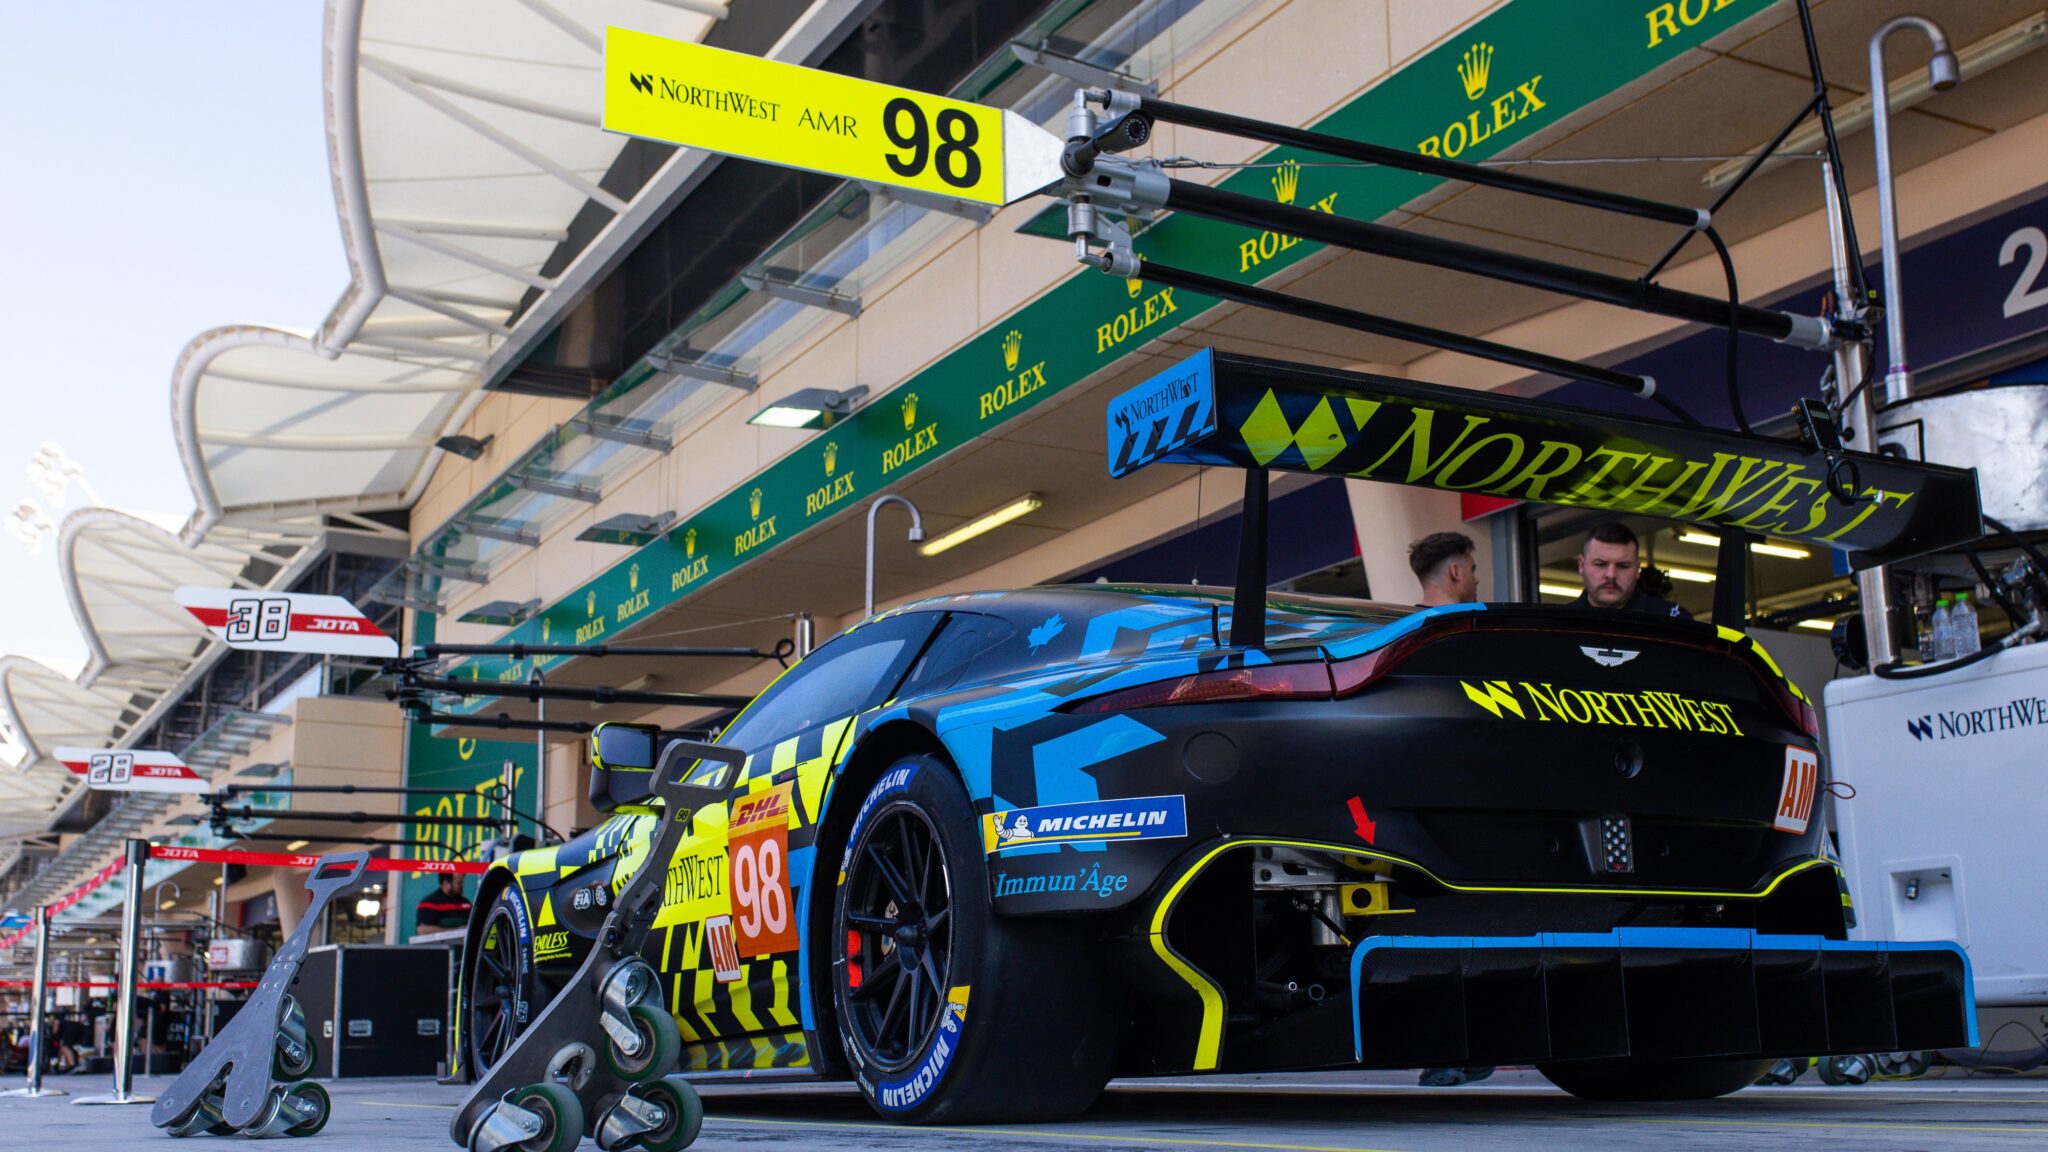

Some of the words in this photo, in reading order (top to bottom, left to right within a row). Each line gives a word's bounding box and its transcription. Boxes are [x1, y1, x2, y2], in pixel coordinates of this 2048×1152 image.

[659, 77, 780, 123] NORTHWEST
[798, 108, 858, 139] AMR
[883, 97, 981, 189] 98
[1096, 286, 1177, 354] ROLEX
[979, 361, 1047, 420] ROLEX
[881, 422, 939, 475] ROLEX
[806, 471, 855, 517] ROLEX
[733, 515, 777, 557] ROLEX
[671, 555, 709, 593] ROLEX
[227, 598, 291, 642] 38
[306, 618, 361, 632] JOTA
[617, 589, 650, 623] ROLEX
[575, 615, 605, 645] ROLEX
[1518, 682, 1745, 737] NORTHWEST
[88, 753, 133, 784] 28
[1779, 759, 1815, 821] AM
[676, 808, 689, 821] 98
[735, 793, 781, 828] DHL
[850, 768, 911, 843] MICHELIN
[1037, 810, 1168, 833] MICHELIN
[157, 848, 199, 859] JOTA
[417, 862, 456, 872] JOTA
[734, 838, 788, 939] 98
[711, 924, 740, 973] AM
[883, 1034, 950, 1107] MICHELIN
